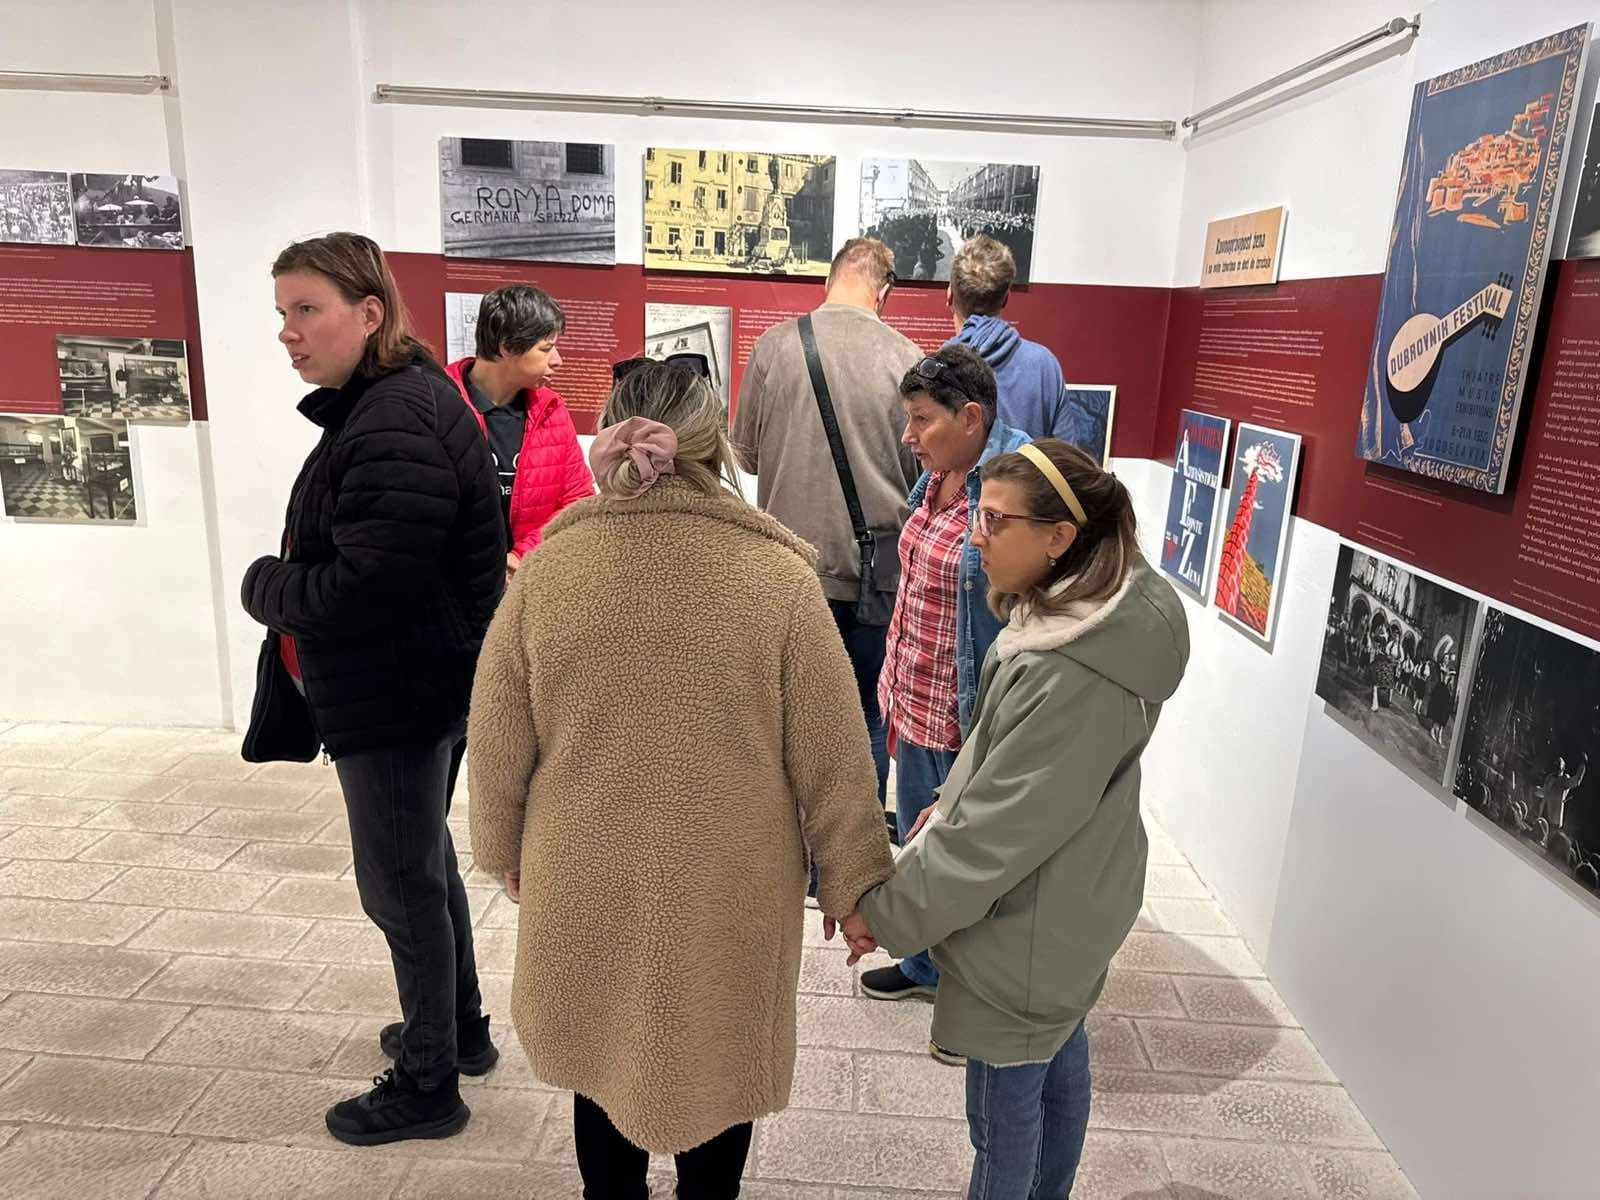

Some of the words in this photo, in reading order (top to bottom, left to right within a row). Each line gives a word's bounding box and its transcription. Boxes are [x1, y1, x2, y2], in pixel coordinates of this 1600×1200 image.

[477, 184, 562, 217] ROMA
[572, 194, 615, 217] DOMA
[451, 211, 520, 224] GERMANIA
[1390, 319, 1449, 376] DUBROVNIK
[1453, 287, 1502, 329] FESTIVAL
